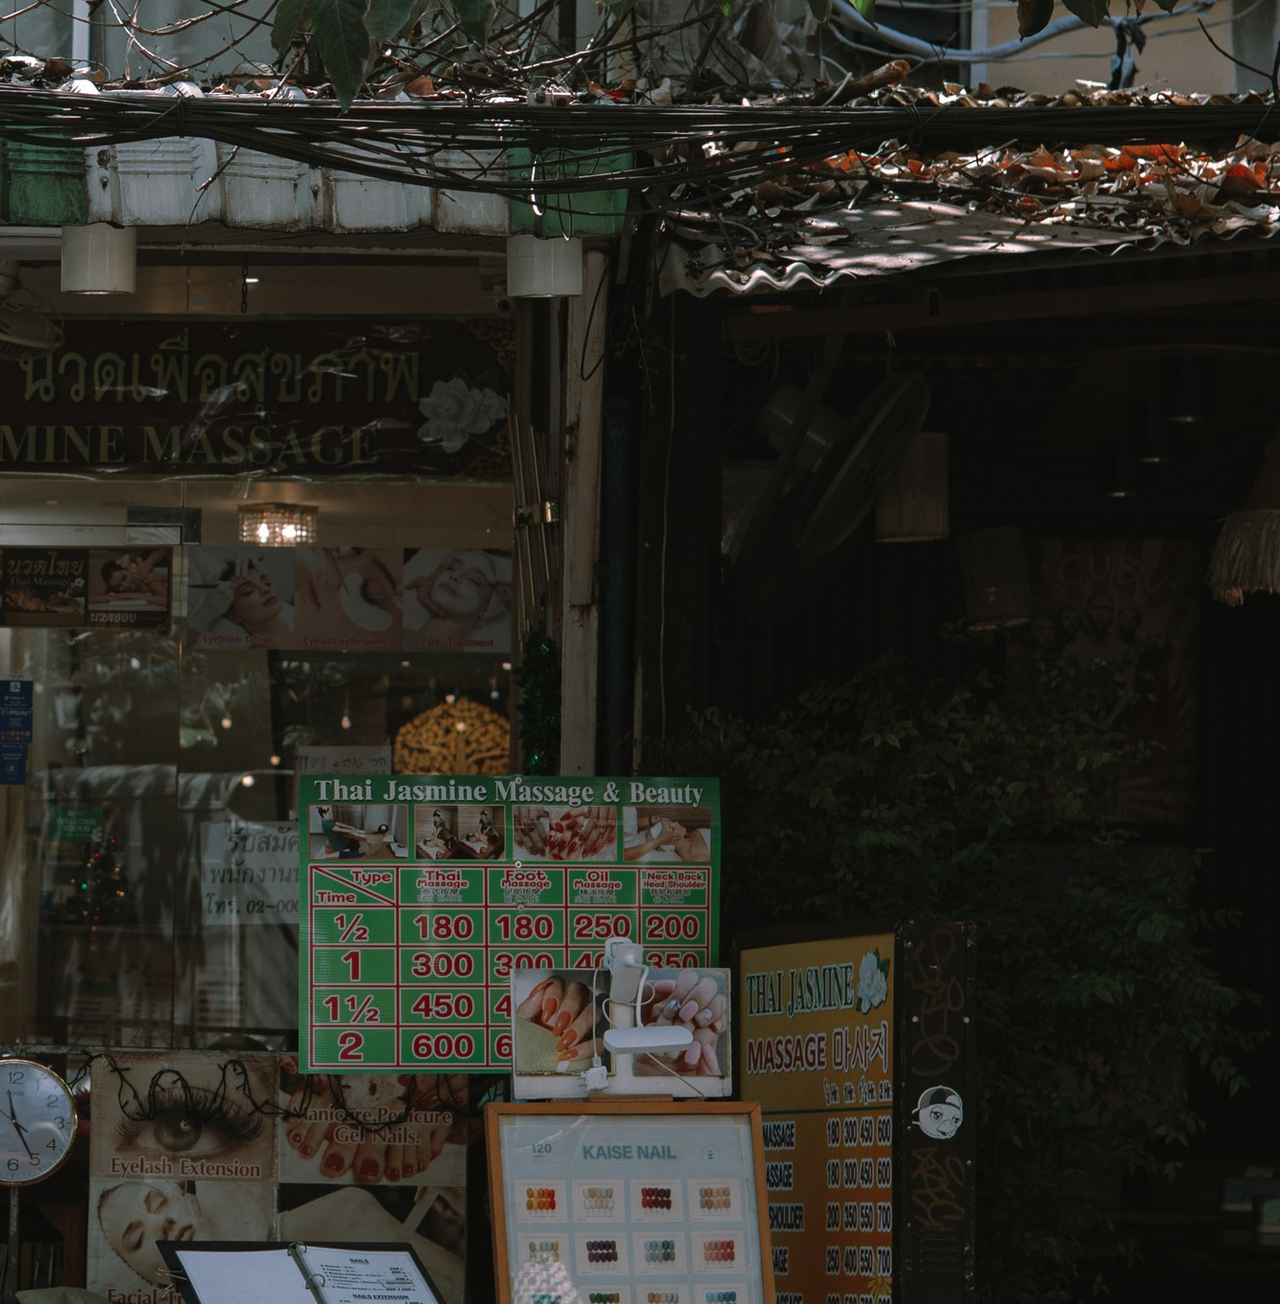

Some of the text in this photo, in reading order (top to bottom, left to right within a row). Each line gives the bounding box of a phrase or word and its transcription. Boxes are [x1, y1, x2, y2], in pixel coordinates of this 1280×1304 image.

[140, 424, 380, 465] MASSAGE
[7, 551, 85, 576] นวดไทย
[11, 576, 72, 588] Thai Massage
[203, 634, 273, 645] Eyebrow tattoo
[304, 636, 387, 646] Eyelash extensions
[422, 638, 494, 647] Face Treatment
[314, 779, 704, 808] Thai Jasmine Massage & Beauty
[351, 870, 392, 885] Type
[424, 870, 461, 881] Thai
[505, 869, 547, 881] Foot
[587, 870, 609, 882] Oil
[647, 871, 703, 881] Neck Back
[417, 880, 468, 889] Massage
[501, 880, 551, 889] Massage
[573, 880, 621, 890] Massage
[643, 880, 706, 888] Head Shoulder
[317, 891, 356, 903] Time
[413, 914, 474, 940] 180
[495, 914, 554, 940] 180
[574, 914, 631, 939] 250
[646, 914, 699, 940] 200
[342, 950, 361, 982] 1
[412, 952, 474, 978] 300
[494, 952, 554, 978] 300
[745, 962, 855, 1019] THAI JASMINE
[411, 993, 474, 1019] 450
[338, 1031, 365, 1062] 2
[412, 1033, 475, 1059] 600
[746, 1020, 889, 1075] MASSAGE 마사지
[8, 1071, 25, 1085] 12
[47, 1095, 59, 1108] 2
[55, 1117, 64, 1130] 3
[826, 1117, 841, 1148] 180
[843, 1116, 858, 1147] 300
[859, 1115, 874, 1146] 450
[876, 1115, 892, 1146] 600
[46, 1139, 57, 1151] 4
[531, 1143, 552, 1154] 120
[582, 1144, 677, 1160] KAISE NAIL
[7, 1158, 19, 1171] 6
[29, 1153, 41, 1166] 5
[111, 1157, 261, 1179] Eyelash Extension
[826, 1158, 841, 1189] 180
[843, 1158, 858, 1189] 300
[859, 1157, 874, 1188] 450
[876, 1156, 892, 1188] 600
[768, 1202, 892, 1232] SHOULDER 200 350 550 700
[826, 1245, 841, 1276] 250
[843, 1245, 858, 1277] 400
[859, 1245, 874, 1277] 550
[876, 1245, 892, 1277] 700
